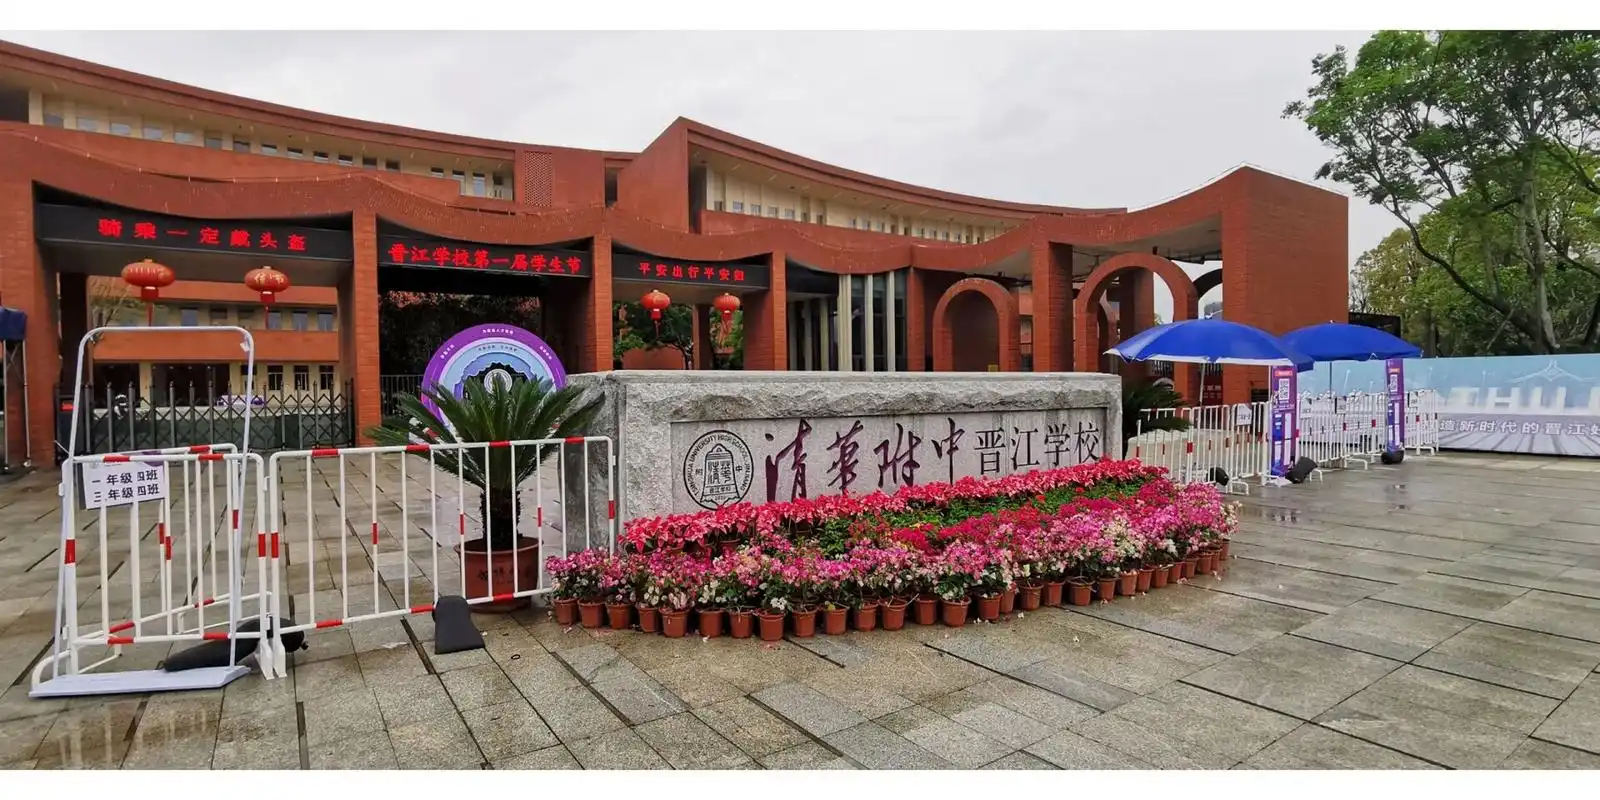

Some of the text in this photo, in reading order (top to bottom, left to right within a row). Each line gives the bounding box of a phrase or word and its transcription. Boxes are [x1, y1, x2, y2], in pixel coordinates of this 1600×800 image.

[98, 218, 306, 251] 骑乘一定戴头盔
[388, 243, 582, 275] 晋江学校第一届学生节
[638, 262, 745, 281] 平安出行平安归
[689, 435, 717, 463] UNIVERSITY
[717, 434, 731, 443] HIGH
[91, 469, 158, 486] 一年级四班
[93, 483, 160, 503] 三年级四班
